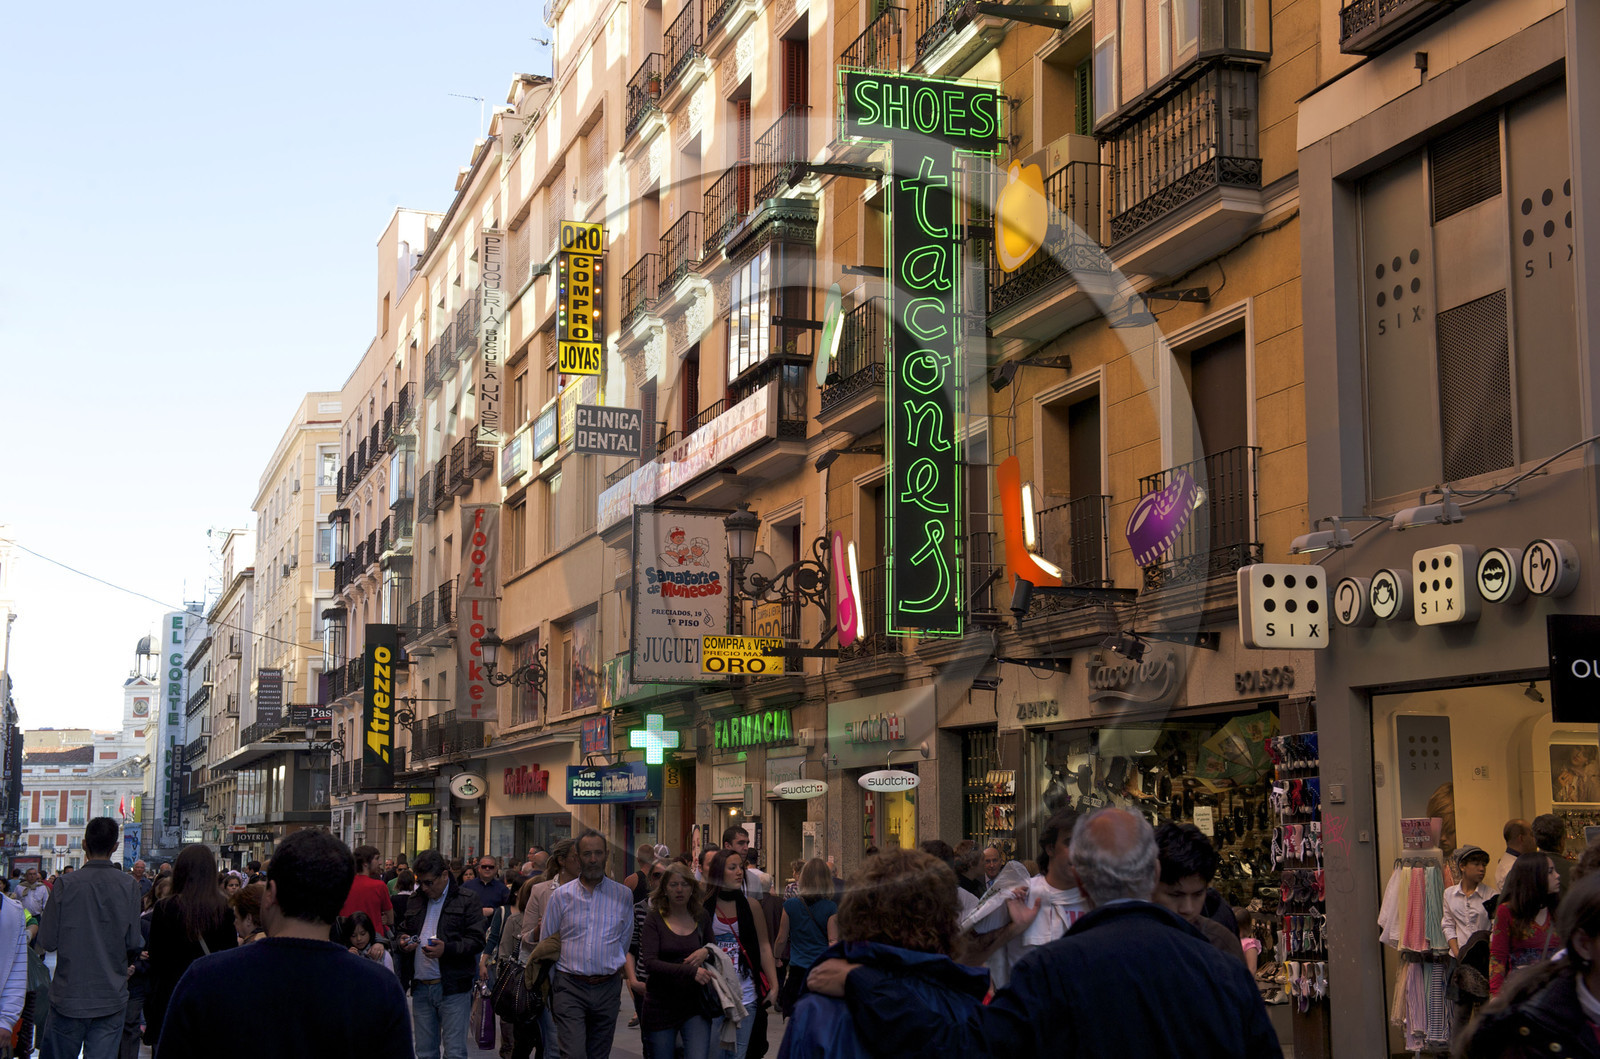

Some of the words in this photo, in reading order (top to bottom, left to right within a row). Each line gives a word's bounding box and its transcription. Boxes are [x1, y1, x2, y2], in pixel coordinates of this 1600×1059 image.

[854, 80, 995, 138] SHOES
[562, 224, 600, 251] ORO
[482, 236, 501, 325] PELUQUERIA
[572, 257, 590, 339] COMPRO
[1378, 305, 1421, 336] SIX
[560, 345, 600, 371] JOYAS
[899, 155, 952, 613] tacones
[481, 384, 499, 438] UNISEX
[577, 408, 641, 432] CLINICA
[578, 430, 638, 453] DENTAL
[470, 508, 487, 587] foot
[645, 566, 720, 586] Sanatorio
[646, 584, 661, 595] de
[660, 579, 723, 599] Muñecos
[651, 608, 693, 617] PRECIADOS,
[1421, 597, 1454, 615] SIX
[172, 616, 184, 644] EL
[678, 618, 700, 627] PISO
[1265, 622, 1320, 639] SIX
[703, 637, 746, 651] COMPRA
[753, 639, 784, 651] VENTA
[705, 656, 767, 674] ORO
[168, 653, 183, 726] CORTE
[1234, 665, 1295, 694] BOLSOS
[367, 646, 392, 764] Atrezzo
[1016, 699, 1060, 720] ZAPATOS
[714, 709, 794, 749] FARMACIA
[844, 711, 889, 745] swatch
[579, 770, 596, 779] The
[1410, 761, 1440, 771] SIX
[572, 779, 601, 788] Phone
[628, 771, 647, 791] House
[781, 784, 817, 795] swatch
[867, 775, 908, 786] swatch
[572, 788, 601, 797] House
[237, 833, 269, 841] JOYERIA
